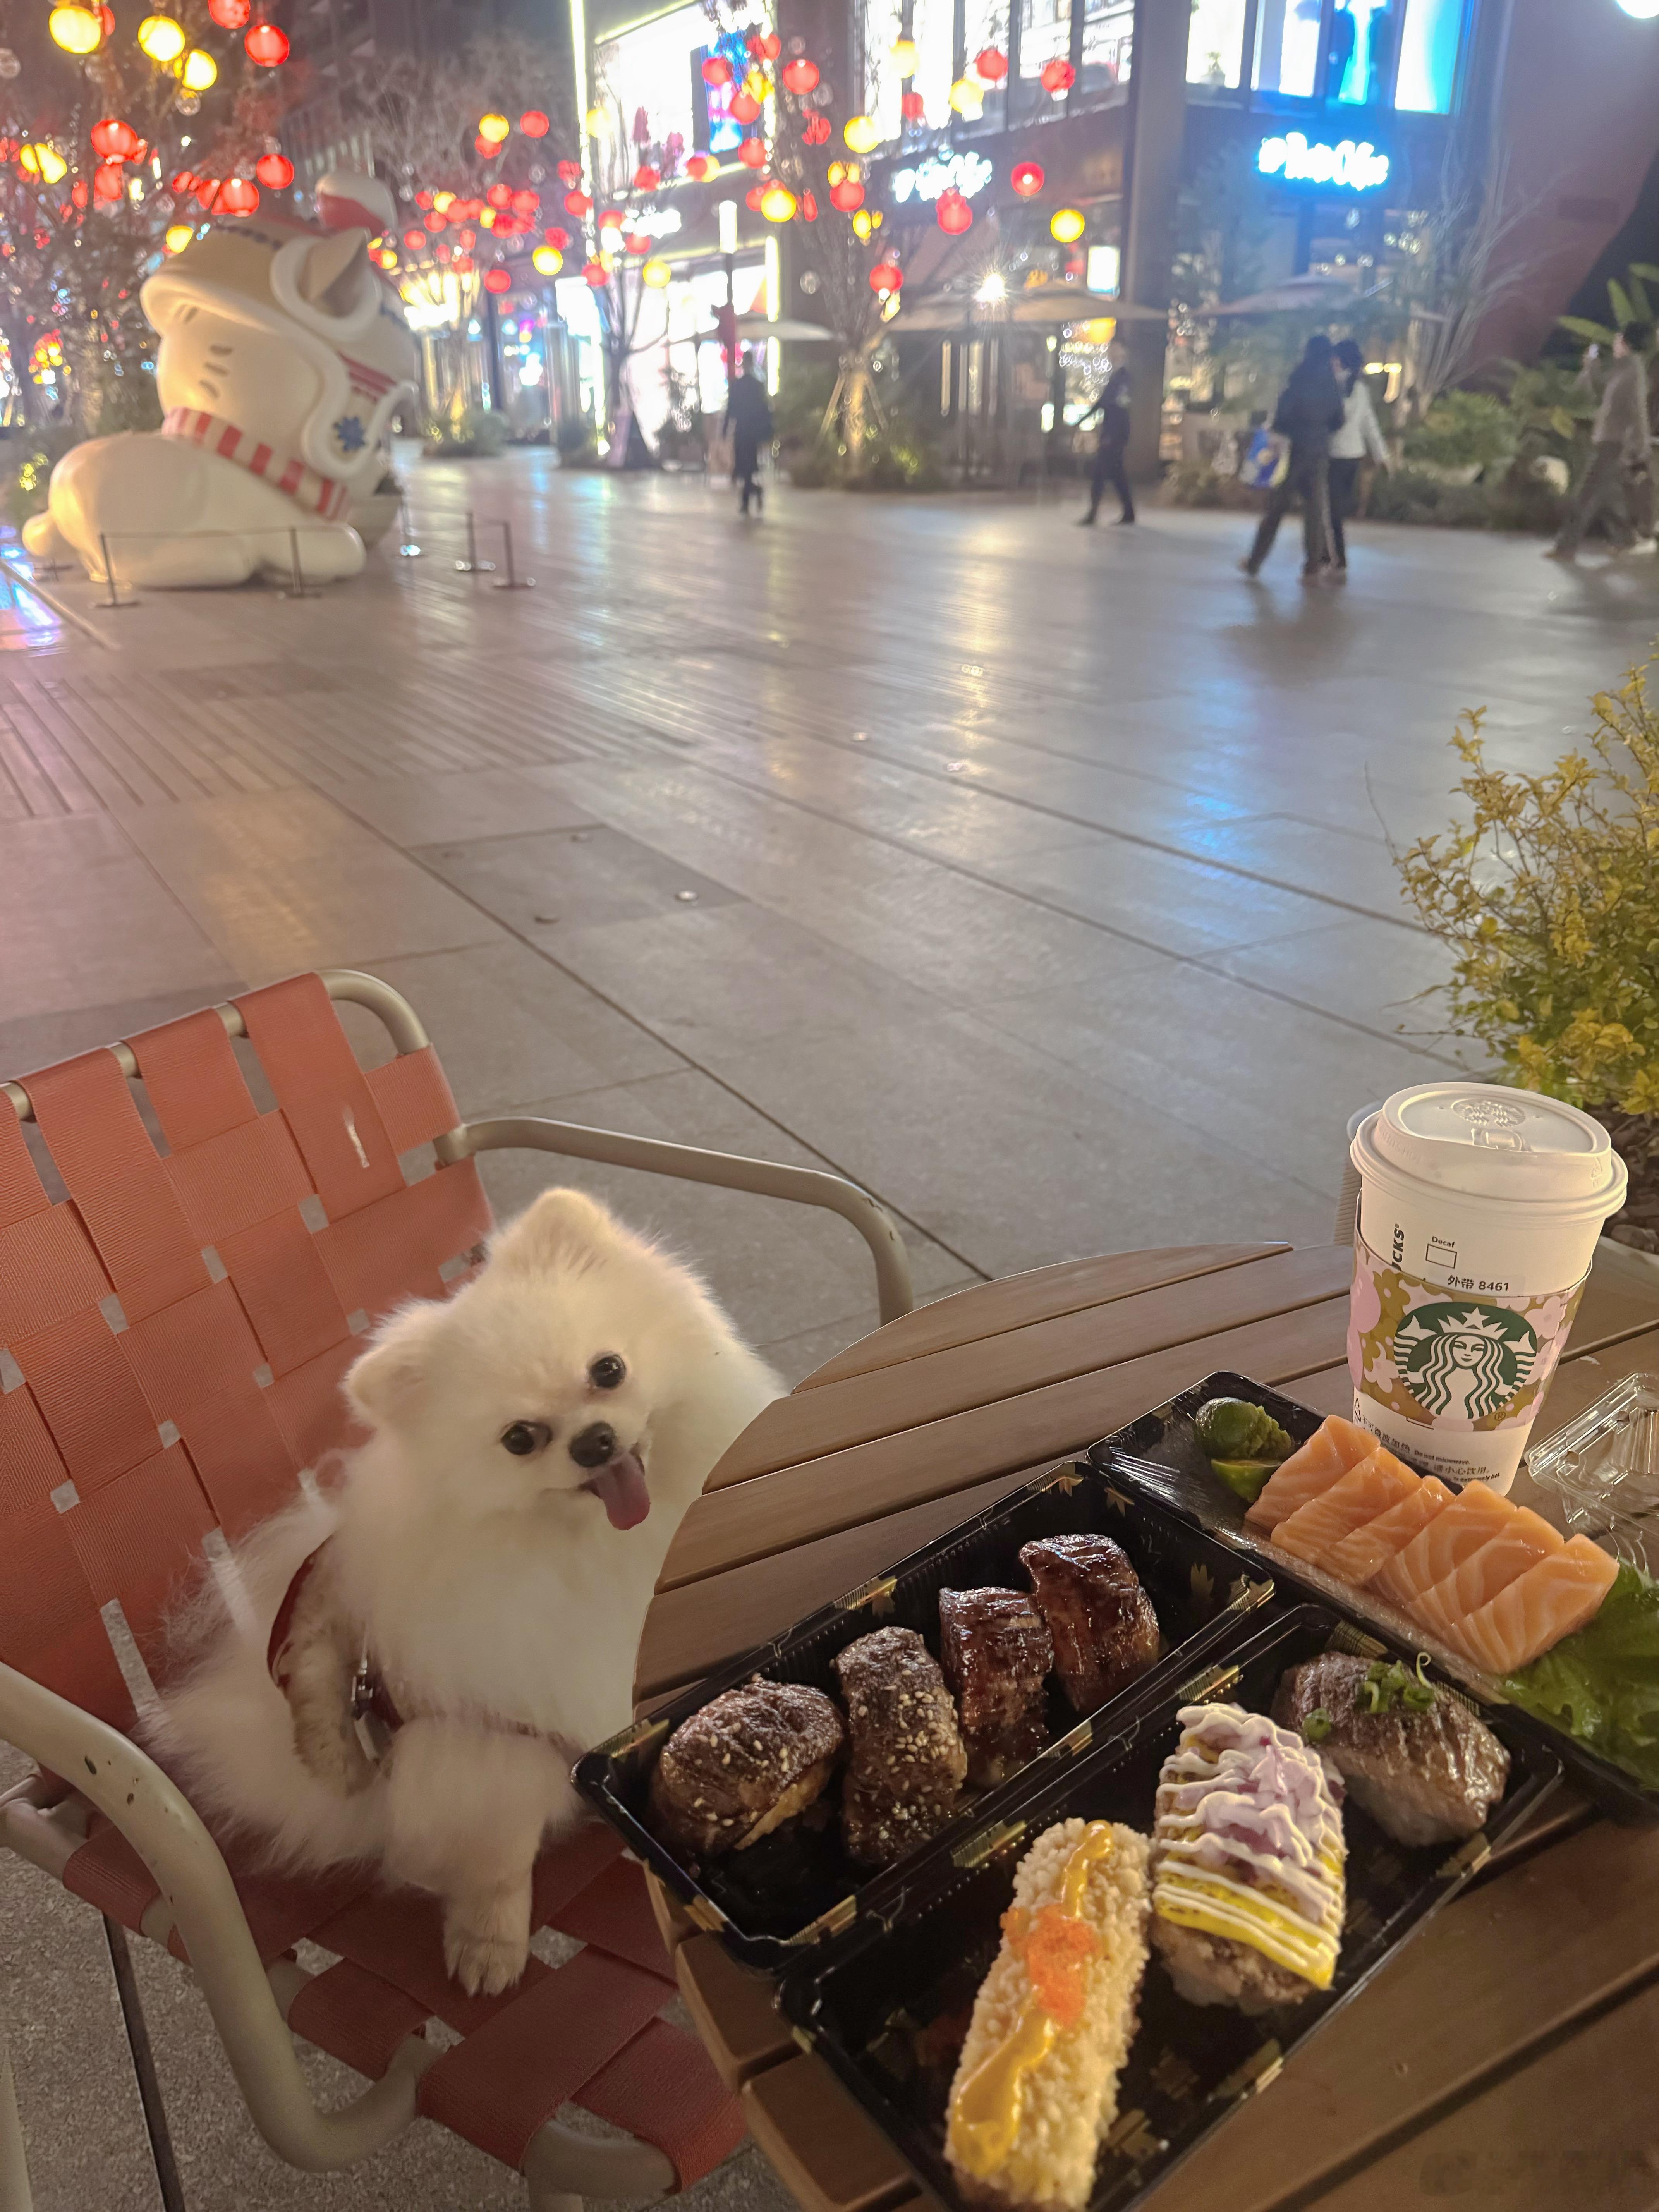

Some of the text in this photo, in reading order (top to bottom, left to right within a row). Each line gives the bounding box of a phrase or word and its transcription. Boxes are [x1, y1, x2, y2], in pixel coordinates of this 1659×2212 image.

[1432, 1236, 1455, 1248] Decaf
[1448, 1275, 1509, 1291] 外带 8461
